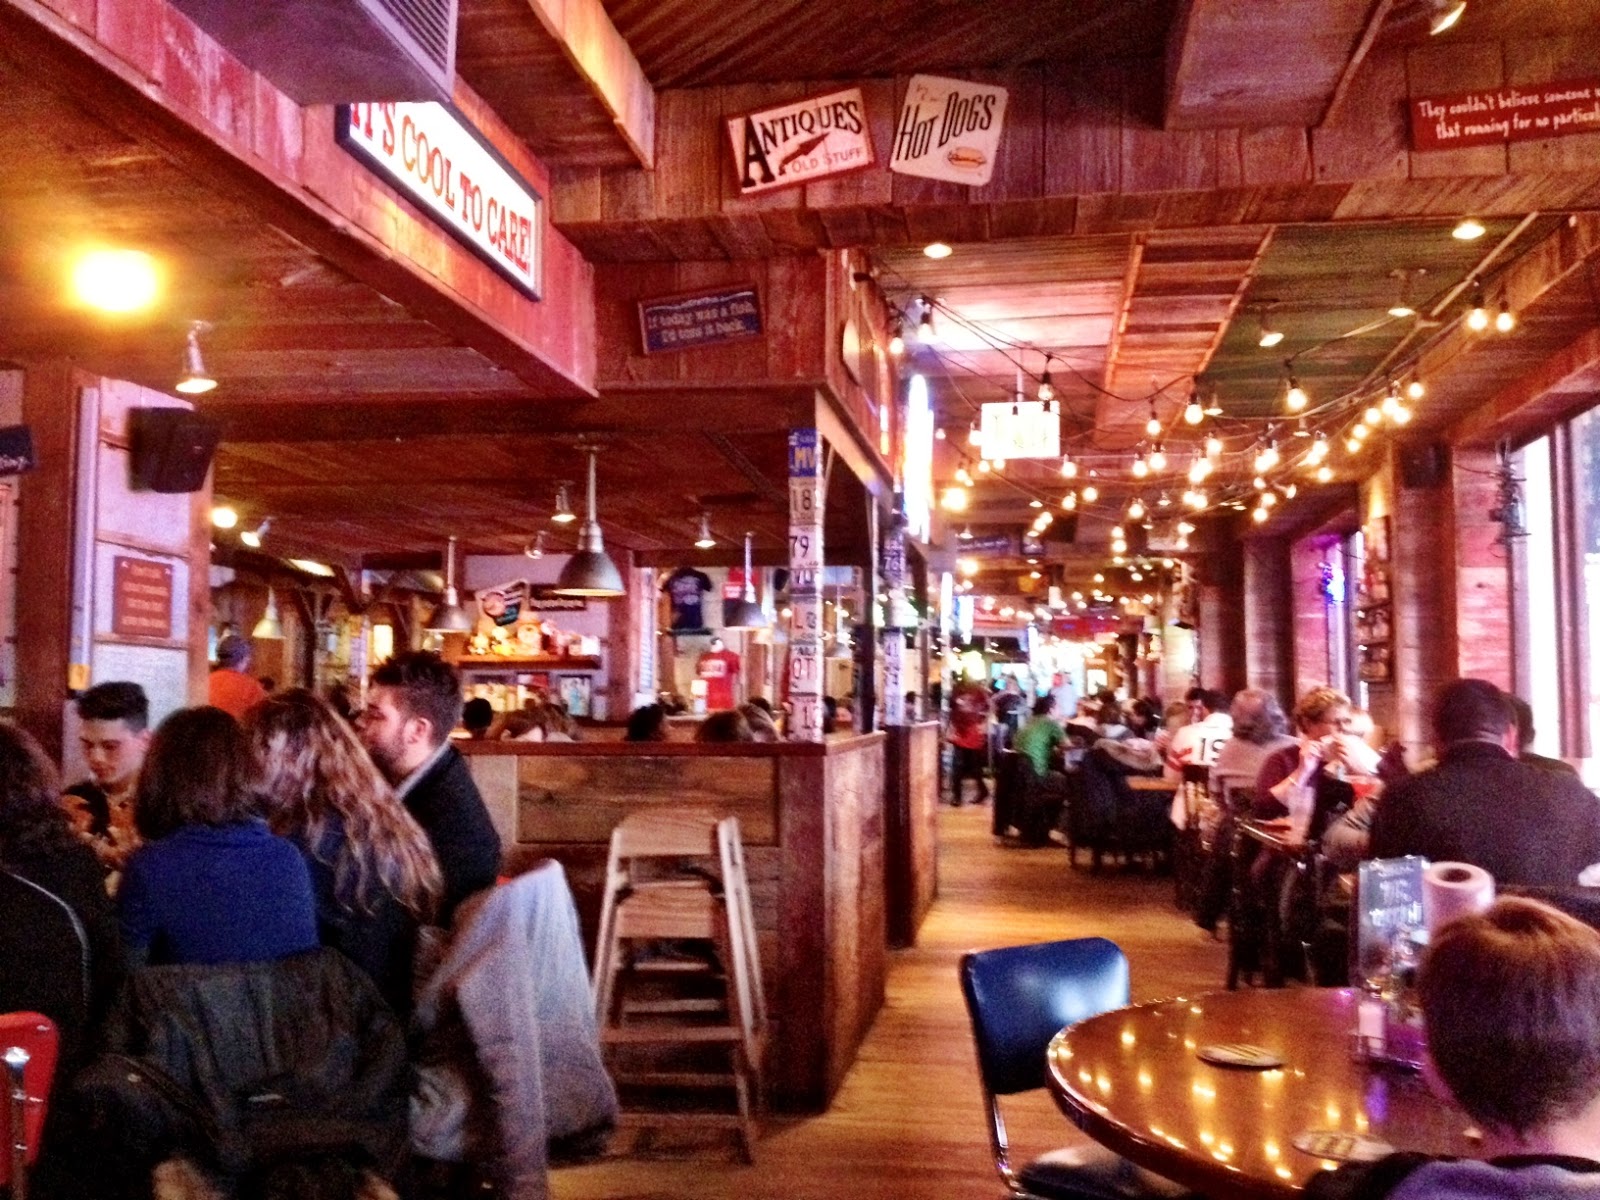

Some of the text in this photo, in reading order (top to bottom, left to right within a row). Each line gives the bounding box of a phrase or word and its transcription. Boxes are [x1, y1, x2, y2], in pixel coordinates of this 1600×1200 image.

[1418, 100, 1445, 123] They
[1498, 91, 1540, 109] believe
[896, 91, 996, 161] HOT DOGS
[1435, 121, 1460, 139] that
[1464, 117, 1510, 137] running
[1513, 112, 1532, 130] for
[1535, 116, 1550, 127] no
[742, 100, 862, 188] ANTIQUES
[402, 114, 455, 211] COOL
[460, 171, 482, 233] TO
[792, 147, 863, 174] OLD STUFF
[789, 535, 809, 559] 79
